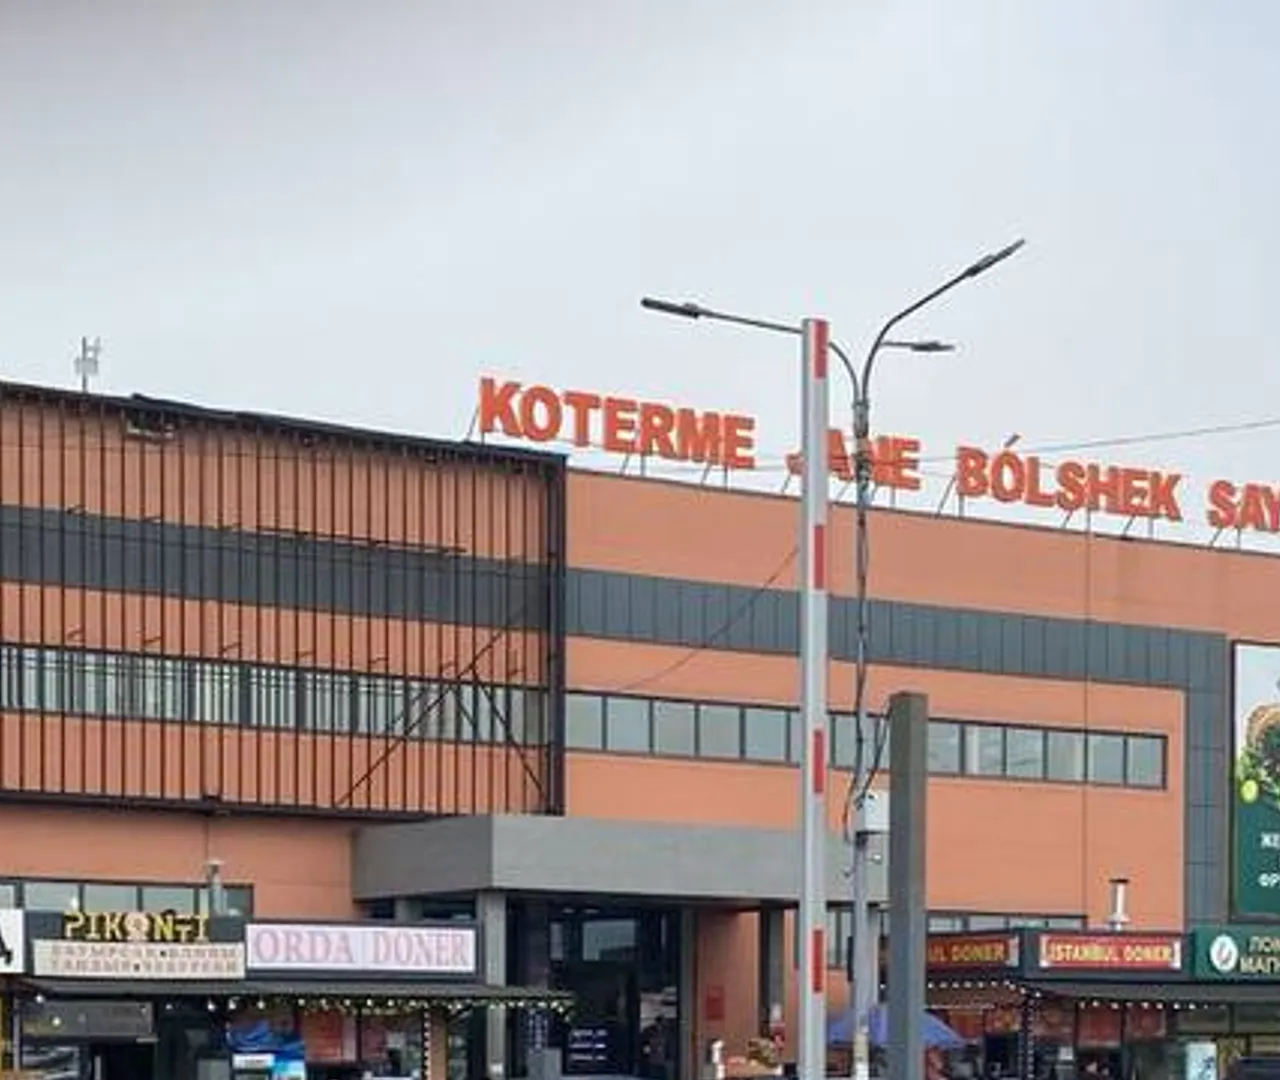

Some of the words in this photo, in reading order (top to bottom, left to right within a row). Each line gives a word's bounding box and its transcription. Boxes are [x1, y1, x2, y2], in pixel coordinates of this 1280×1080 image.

[478, 378, 755, 469] KOTERME
[786, 428, 920, 490] ANE
[954, 434, 1184, 520] BÓLSHEK
[254, 928, 354, 964] ORDA
[372, 930, 469, 966] DONER
